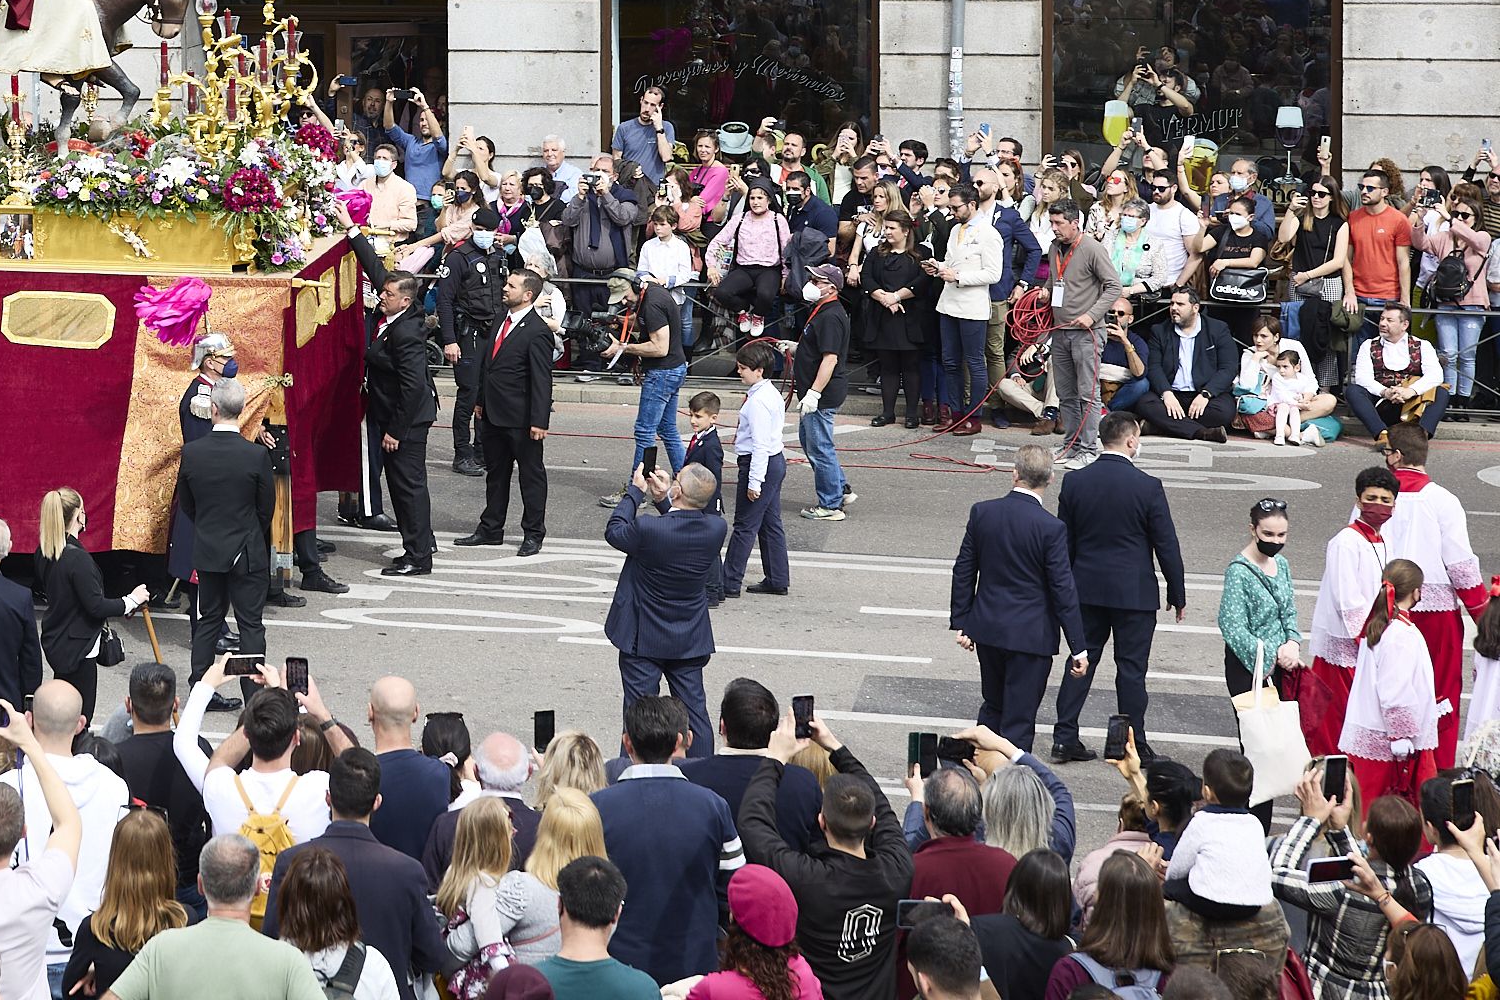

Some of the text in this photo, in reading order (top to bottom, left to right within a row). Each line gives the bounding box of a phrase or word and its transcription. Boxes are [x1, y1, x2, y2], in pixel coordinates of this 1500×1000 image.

[734, 62, 749, 79] y
[752, 54, 847, 102] Meriendas
[1159, 106, 1243, 143] VERMUT
[1215, 284, 1248, 296] adidas
